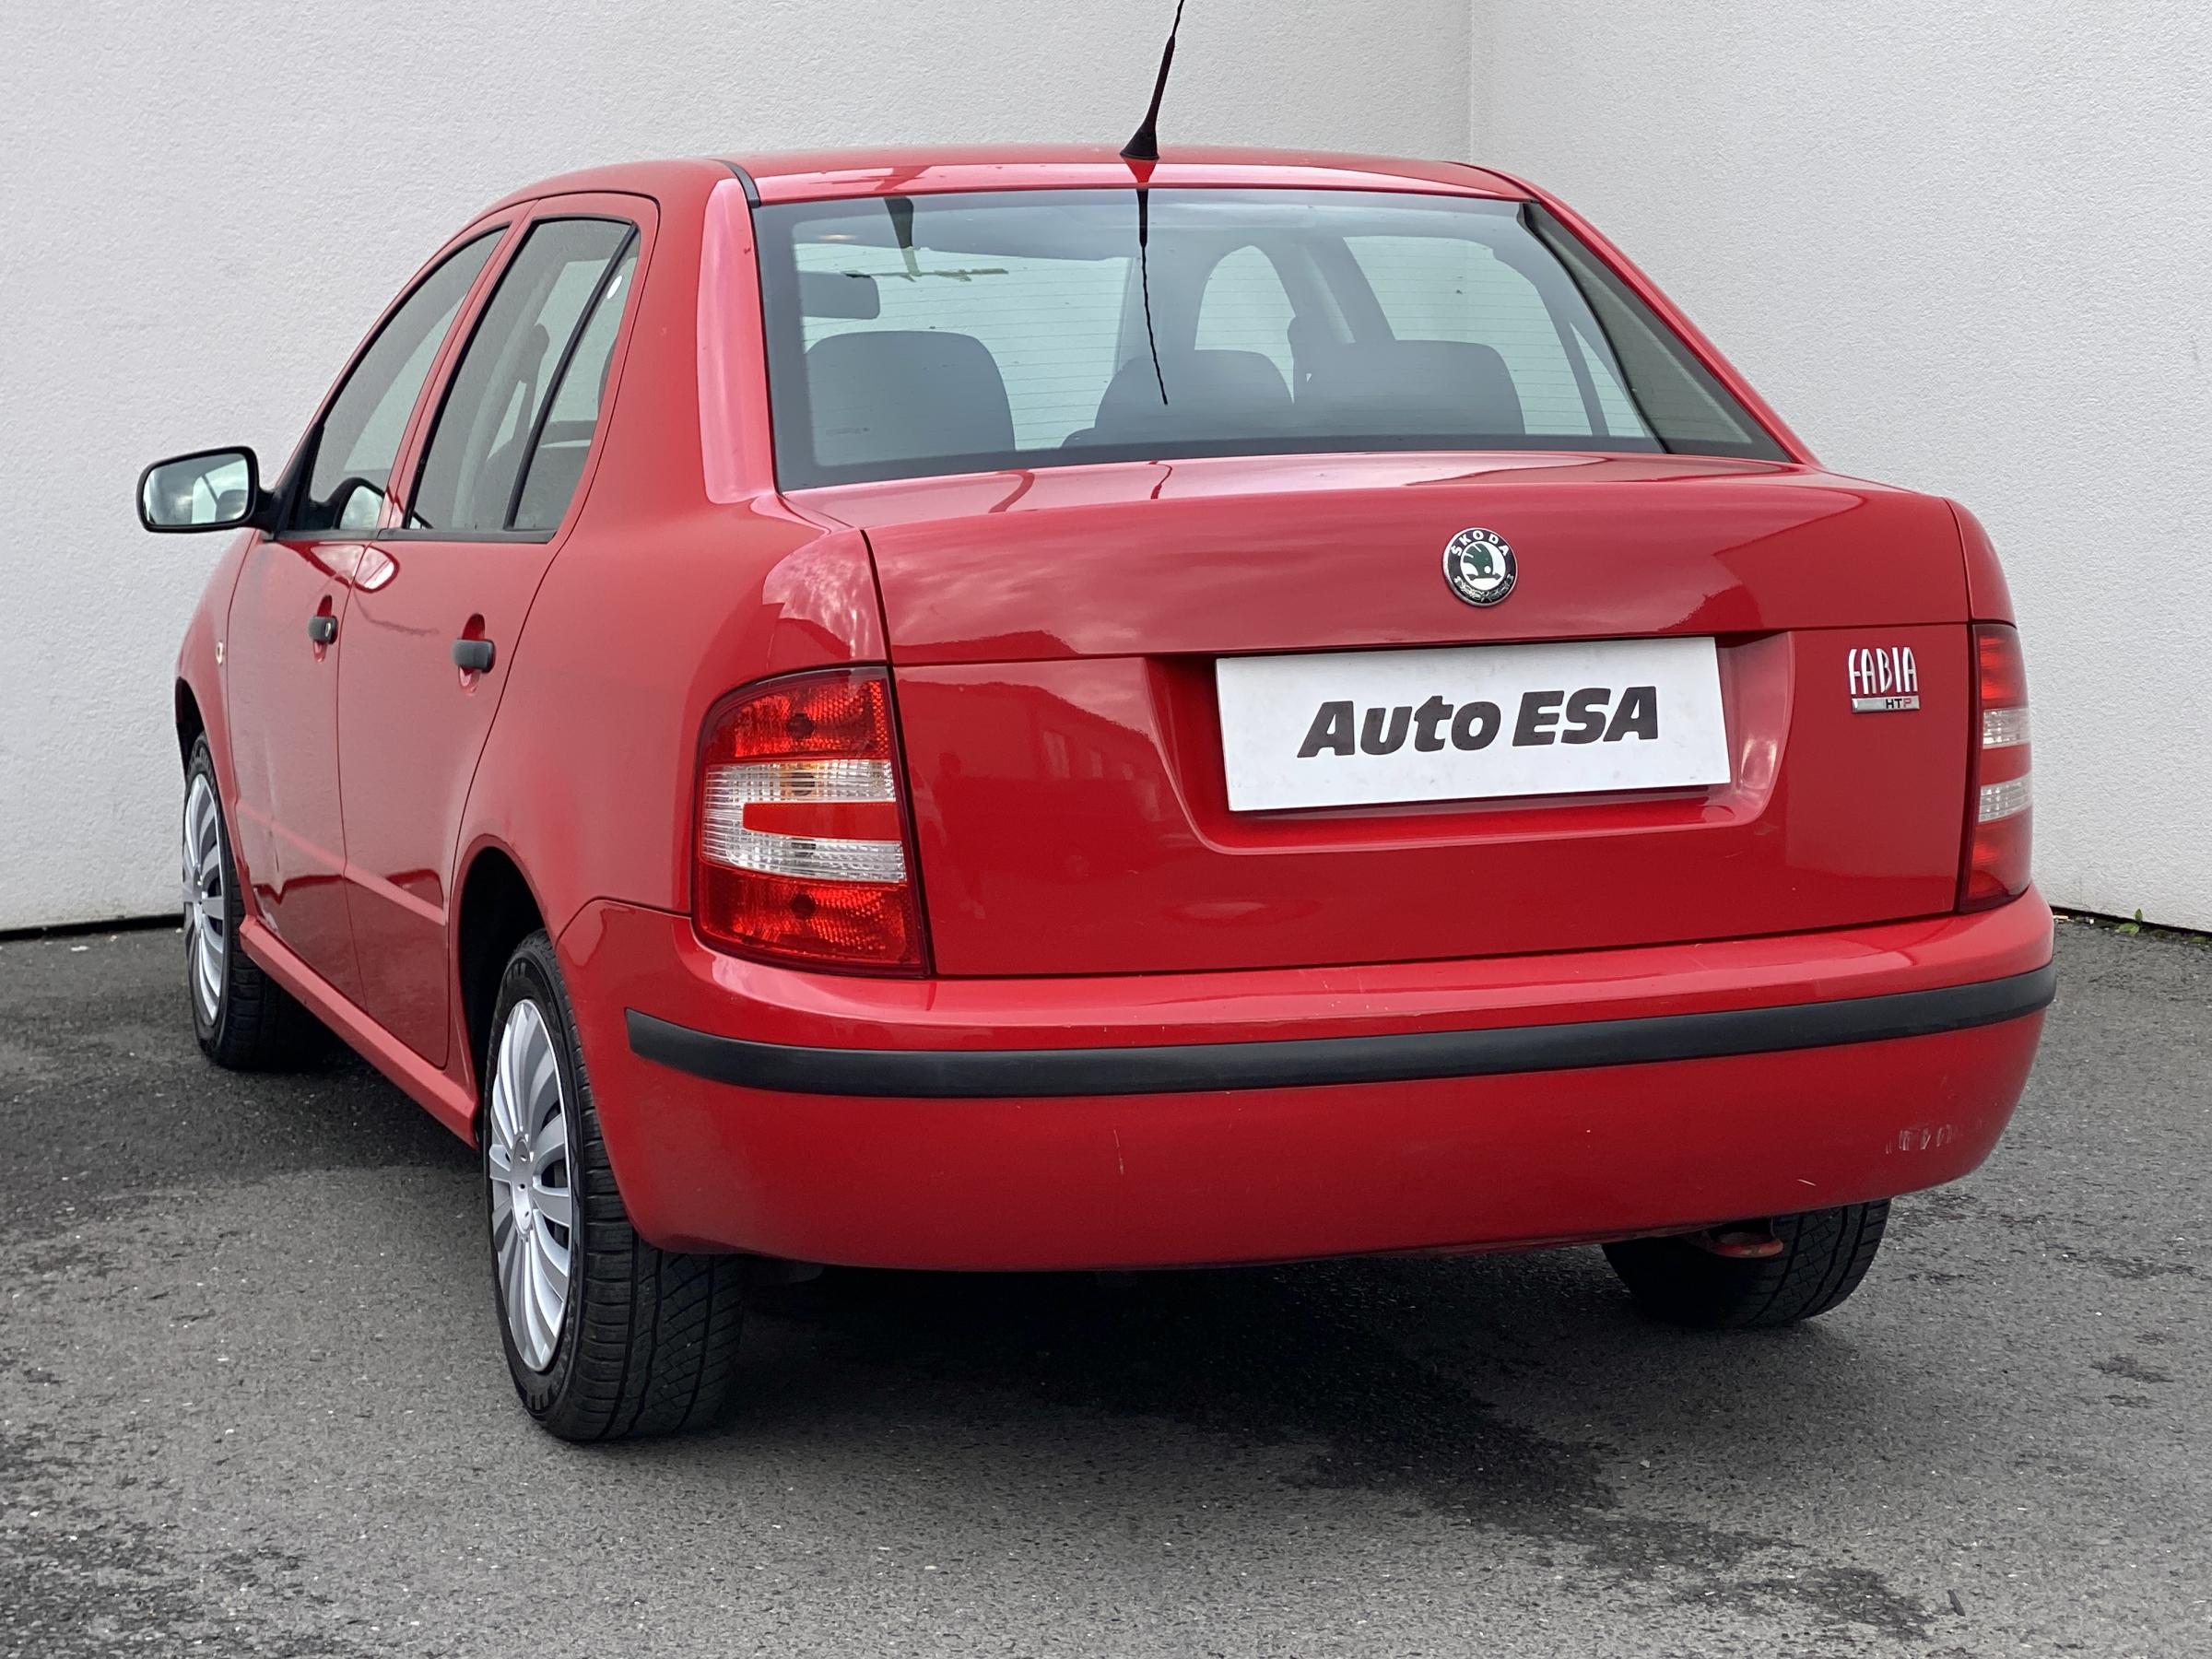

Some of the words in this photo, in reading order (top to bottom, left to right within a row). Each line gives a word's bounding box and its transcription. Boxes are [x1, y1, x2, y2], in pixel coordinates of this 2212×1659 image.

[1848, 646, 1917, 694] FABIA
[1297, 695, 1501, 758] Auto
[1512, 686, 1658, 747] ESA
[1886, 698, 1912, 709] HTP
